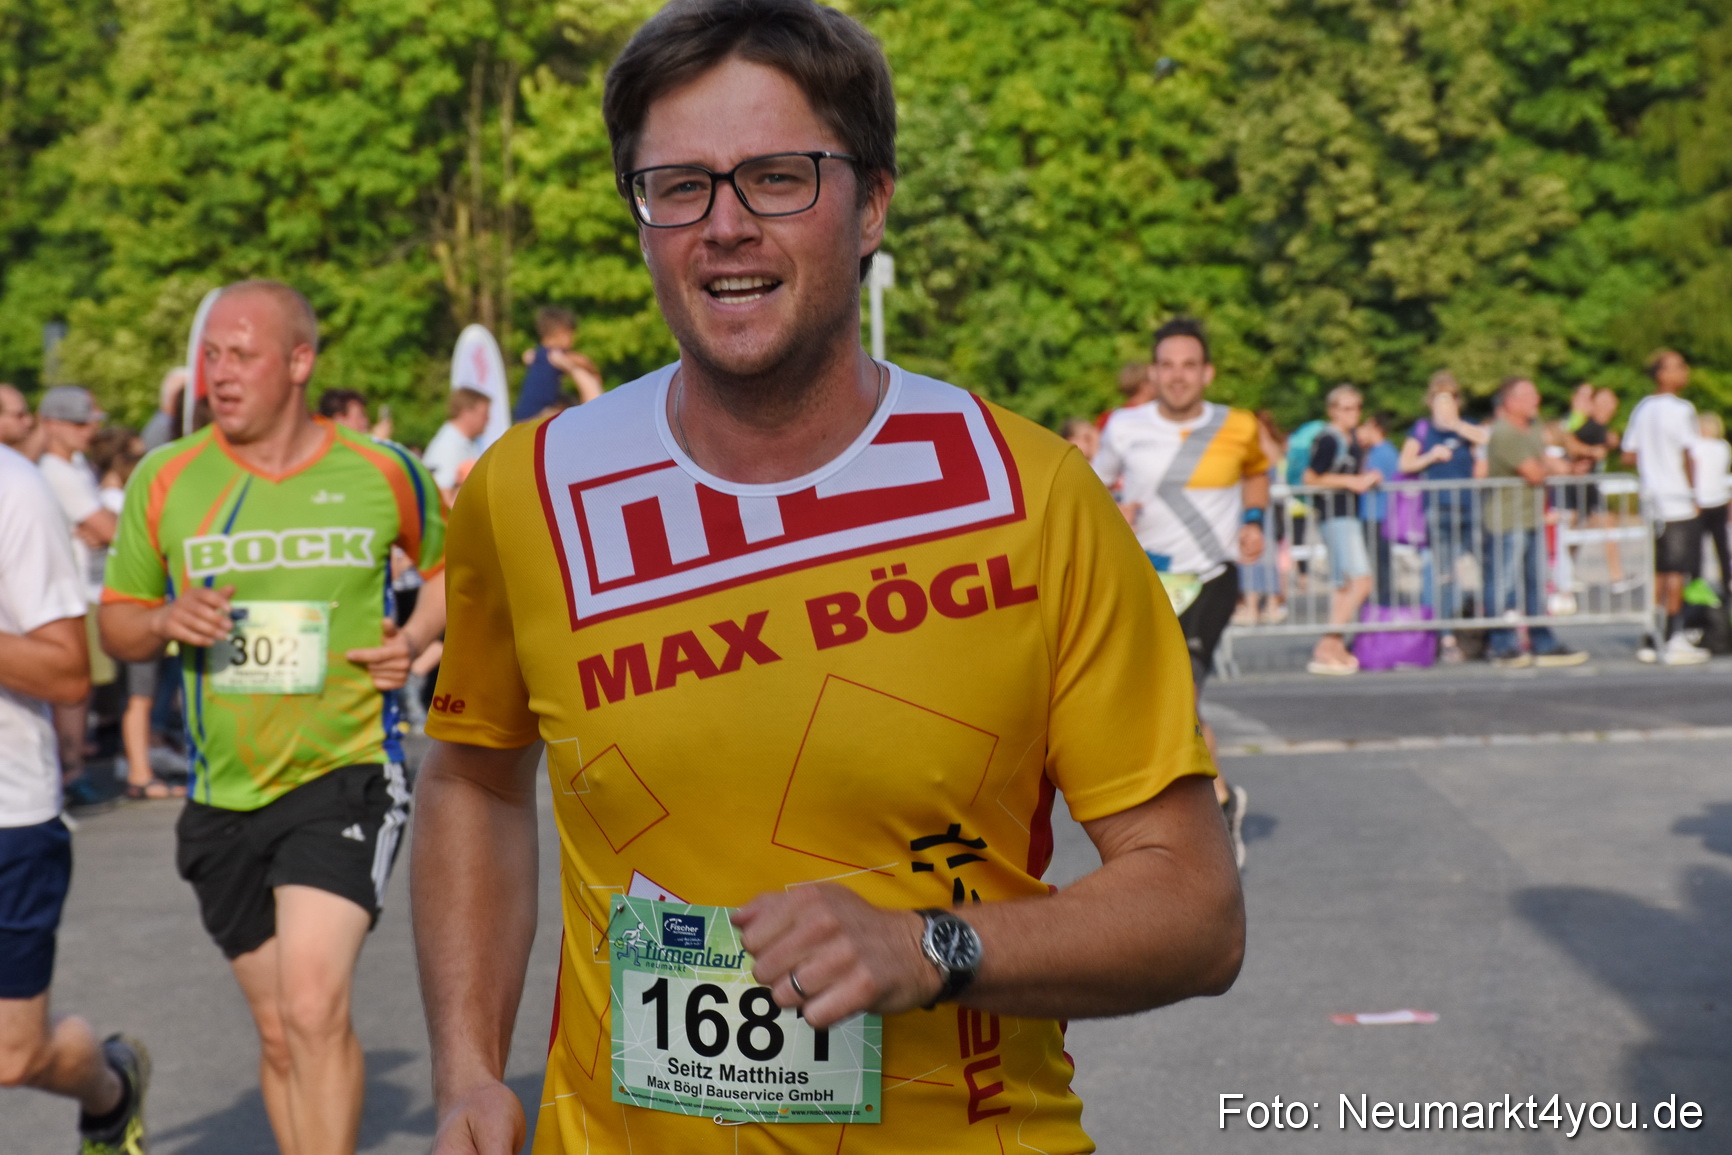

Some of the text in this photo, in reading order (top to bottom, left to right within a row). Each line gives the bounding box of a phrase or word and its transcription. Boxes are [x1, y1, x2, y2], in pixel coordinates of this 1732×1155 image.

[183, 528, 376, 577] BOCK
[577, 554, 1039, 711] MAX BÖGL
[670, 923, 699, 933] Fischer
[645, 940, 746, 969] firmenlauf
[645, 961, 686, 973] neumarkt
[667, 1057, 809, 1085] Seitz Matthias
[647, 1075, 834, 1102] Max Bögl Bauservice GmbH
